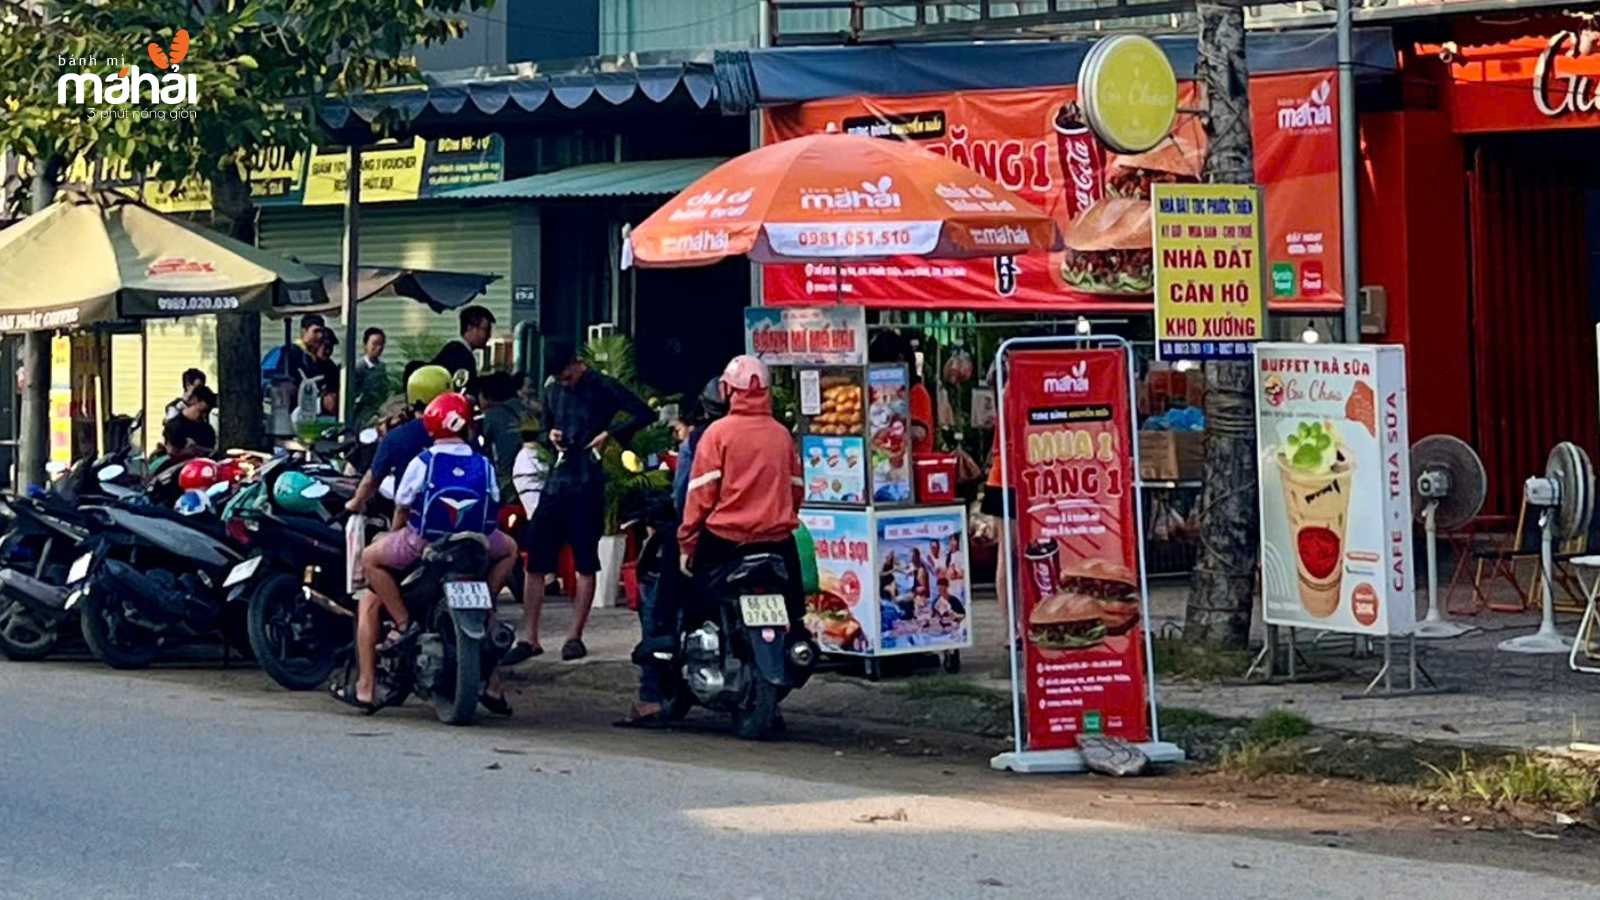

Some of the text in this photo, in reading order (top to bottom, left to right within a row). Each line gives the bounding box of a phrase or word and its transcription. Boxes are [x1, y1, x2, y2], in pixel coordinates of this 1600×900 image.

[1030, 143, 1053, 192] 1
[798, 231, 911, 246] 0981.051.510
[1163, 244, 1253, 269] NHÀ ĐẤT
[1221, 279, 1249, 307] HỘ
[1166, 317, 1197, 337] KHO
[1261, 359, 1309, 373] BUFFET
[1314, 356, 1339, 375] TRÀ
[1028, 430, 1093, 464] MUA
[1105, 467, 1122, 498] 1
